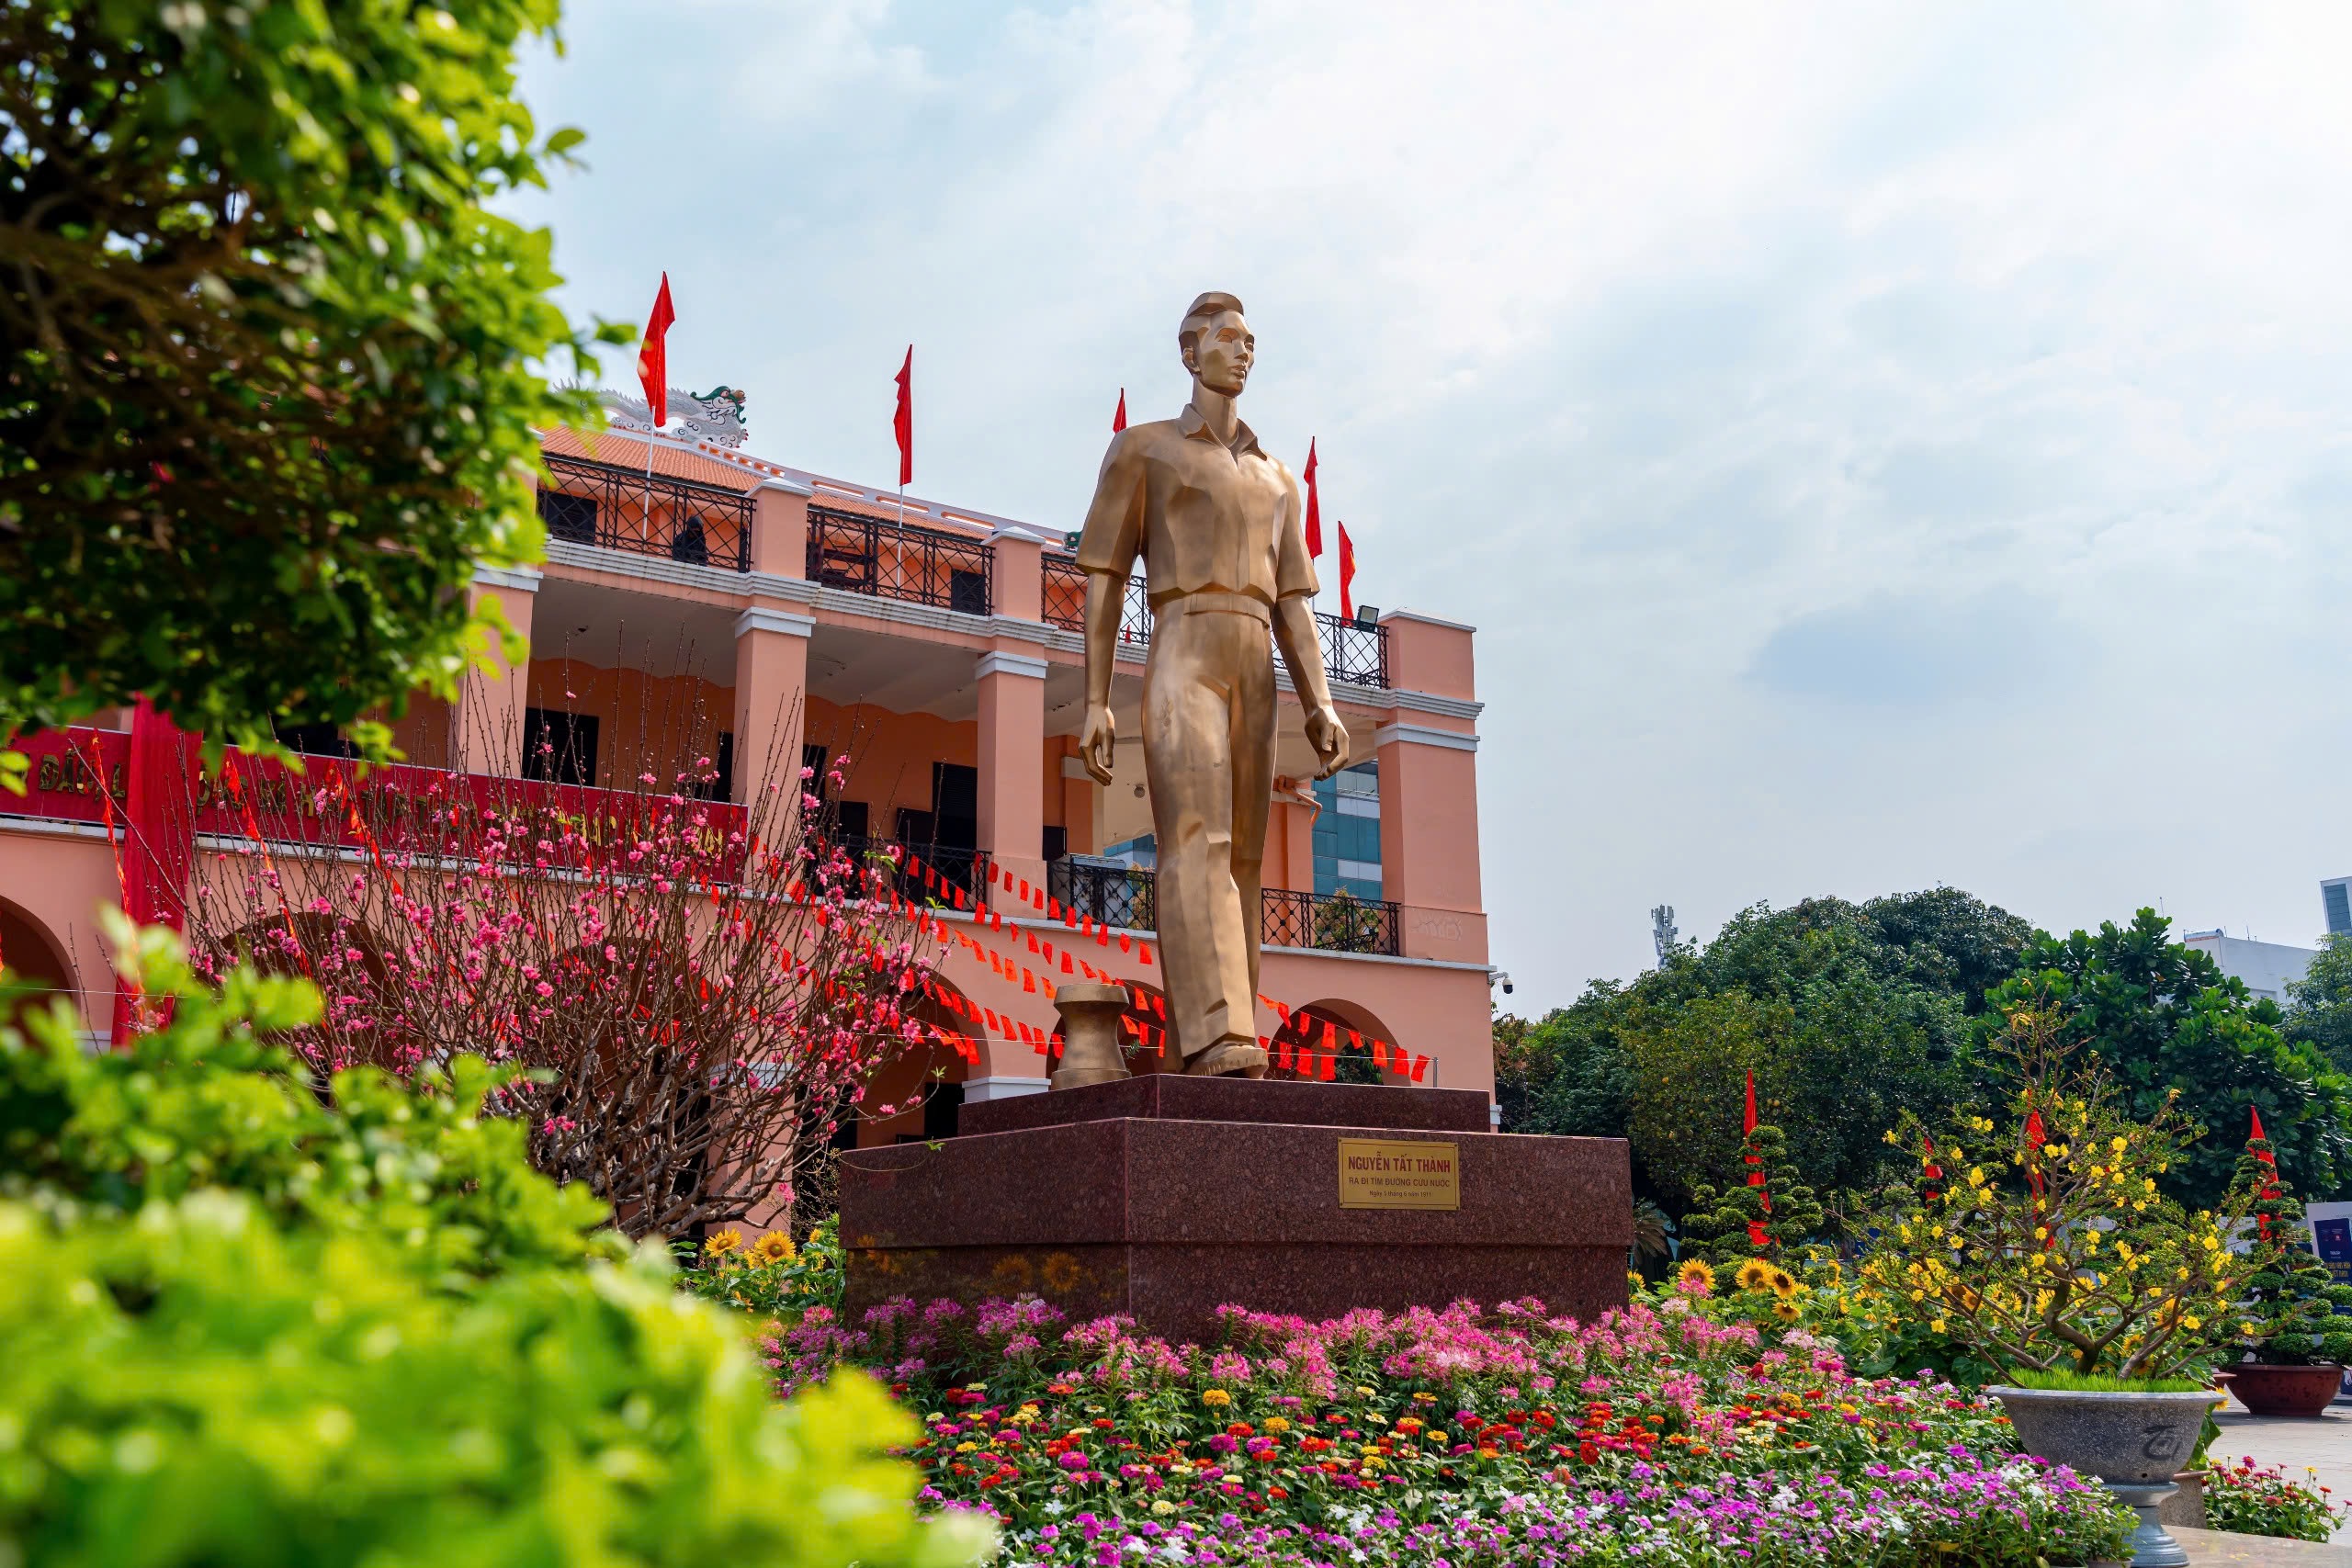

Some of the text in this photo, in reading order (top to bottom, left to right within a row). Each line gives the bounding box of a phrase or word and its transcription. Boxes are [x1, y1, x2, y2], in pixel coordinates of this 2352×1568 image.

[1348, 1151, 1450, 1173] NGUYỄN TẤT THÀNH
[1370, 1177, 1383, 1185] TÌM
